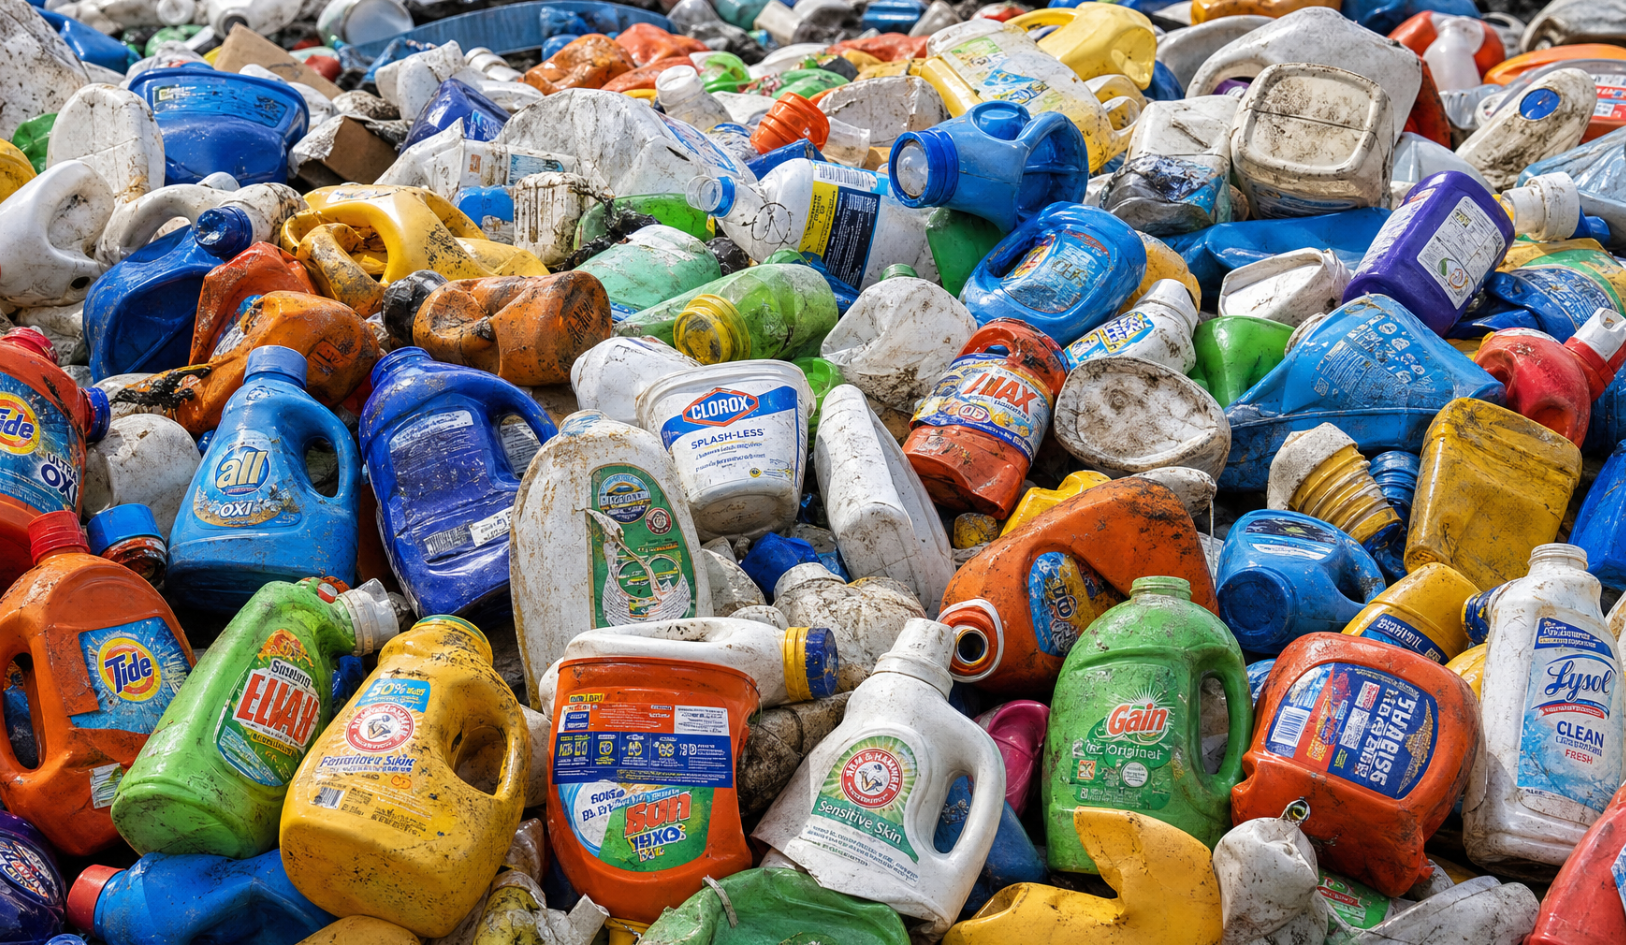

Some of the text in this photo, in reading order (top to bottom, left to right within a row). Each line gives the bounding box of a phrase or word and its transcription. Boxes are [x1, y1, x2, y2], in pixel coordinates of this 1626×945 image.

[691, 395, 749, 420] CLOROX
[691, 428, 764, 450] SPLASH-LESS
[48, 453, 78, 482] ULTRA
[216, 451, 268, 489] all
[41, 463, 78, 507] OXI
[219, 502, 254, 518] OXI
[104, 651, 153, 694] Tide
[1544, 659, 1612, 702] Lysol
[1108, 703, 1169, 736] Gain
[1556, 720, 1605, 750] CLEAN
[1564, 748, 1594, 765] FRESH
[818, 800, 902, 845] Sensitive Skin
